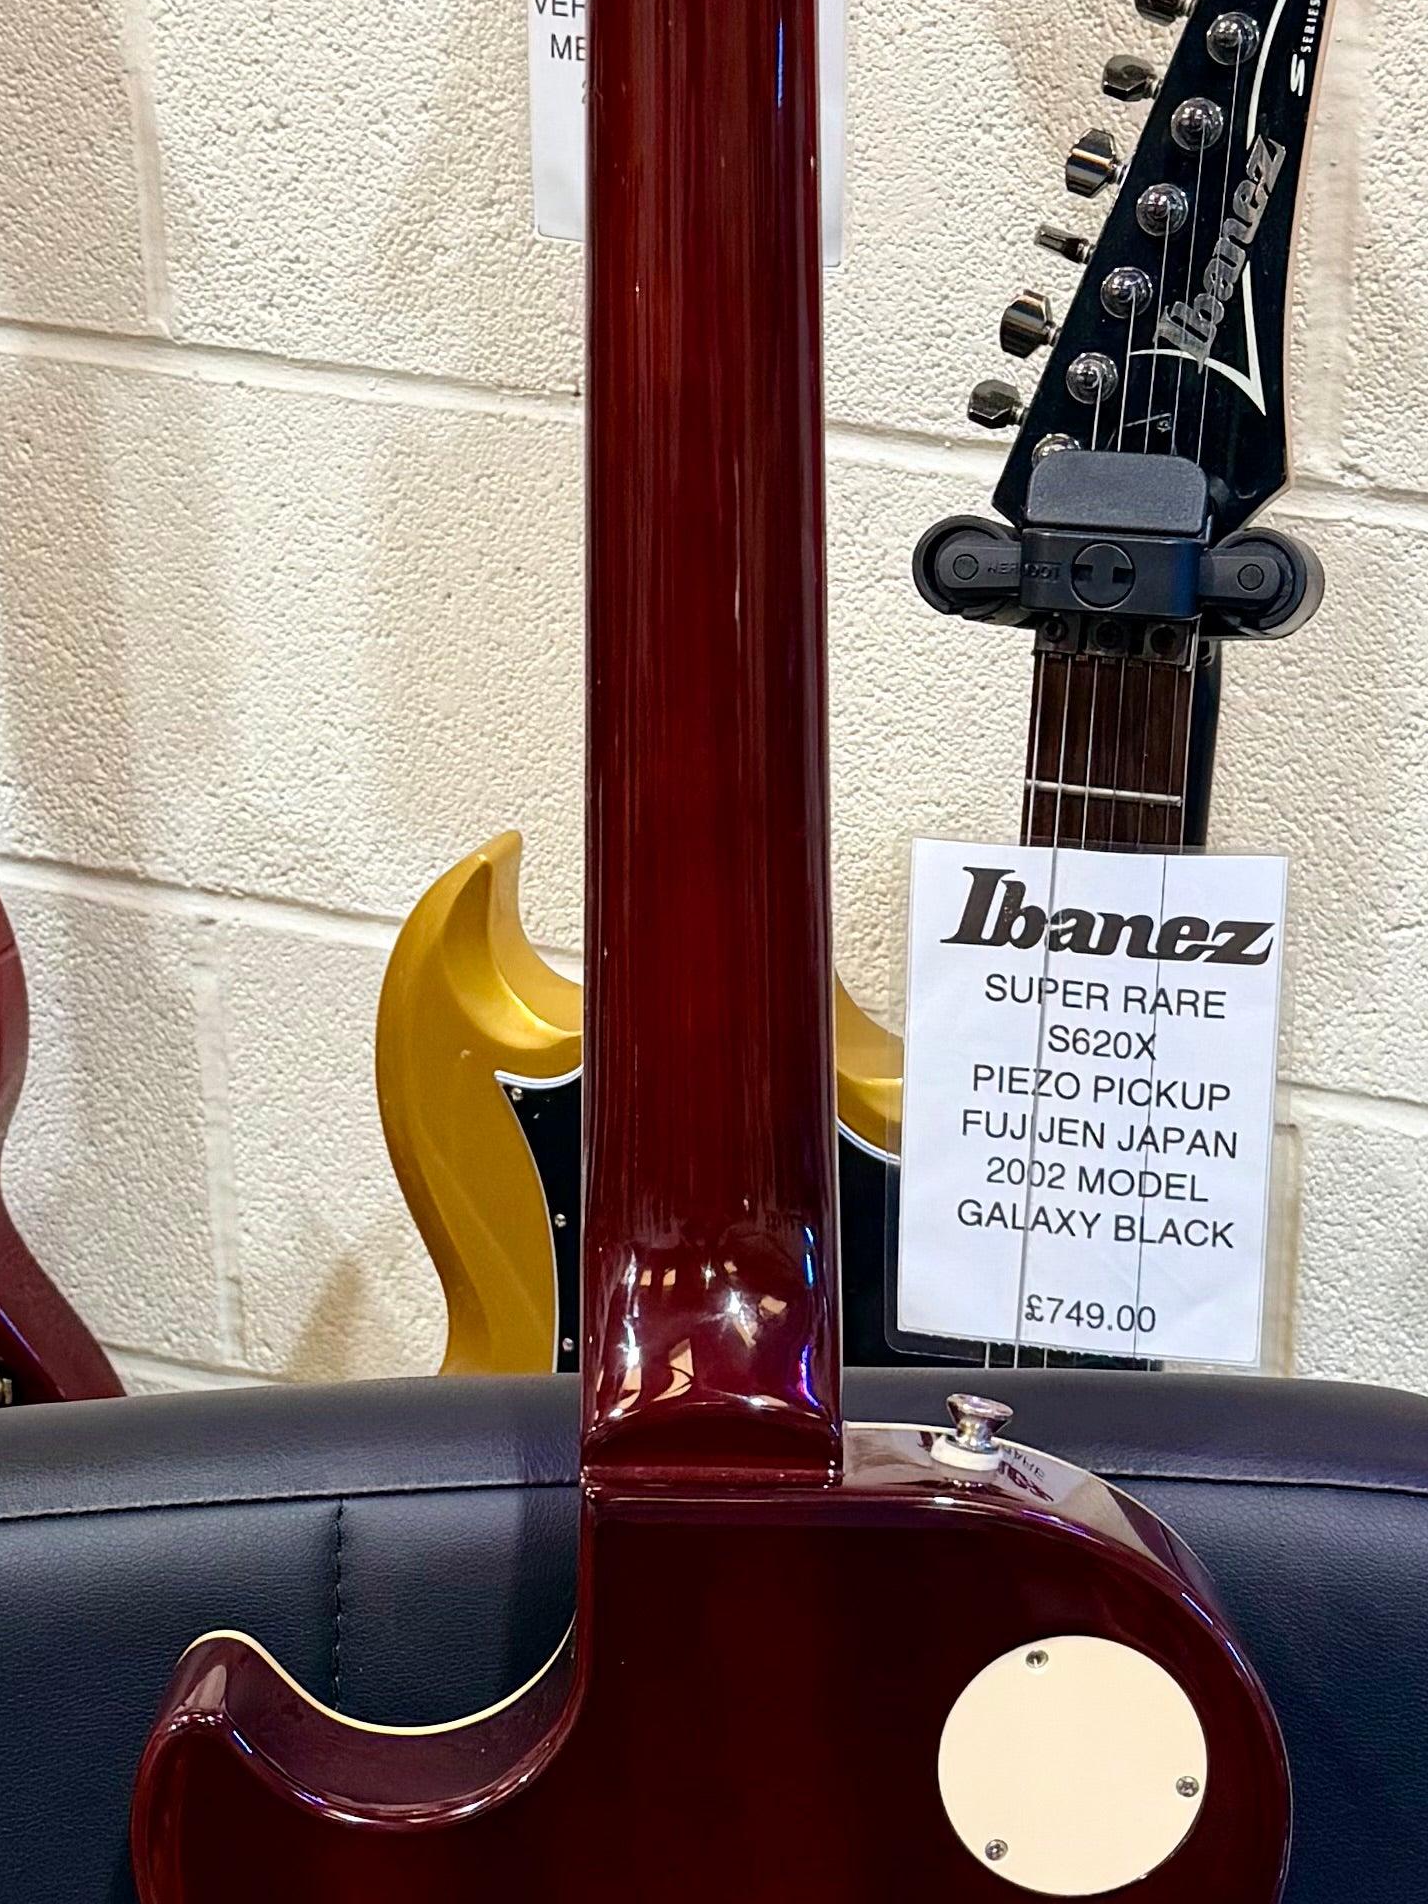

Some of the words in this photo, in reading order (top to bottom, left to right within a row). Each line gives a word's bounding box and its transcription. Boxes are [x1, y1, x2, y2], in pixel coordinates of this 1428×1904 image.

[1152, 133, 1287, 375] Ibanez
[940, 866, 1275, 966] Ibanez
[985, 974, 1110, 1012] SUPER
[1123, 985, 1228, 1020] RARE
[1047, 1025, 1157, 1060] S620X
[972, 1063, 1081, 1101] PIEZO
[1094, 1075, 1232, 1112] PICKUP
[1118, 1125, 1238, 1159] JAPAN
[986, 1157, 1065, 1191] 2002
[1077, 1166, 1209, 1203] MODEL
[957, 1199, 1101, 1240] GALAXY
[1114, 1215, 1234, 1249] BLACK
[1025, 1295, 1157, 1334] £749.00
